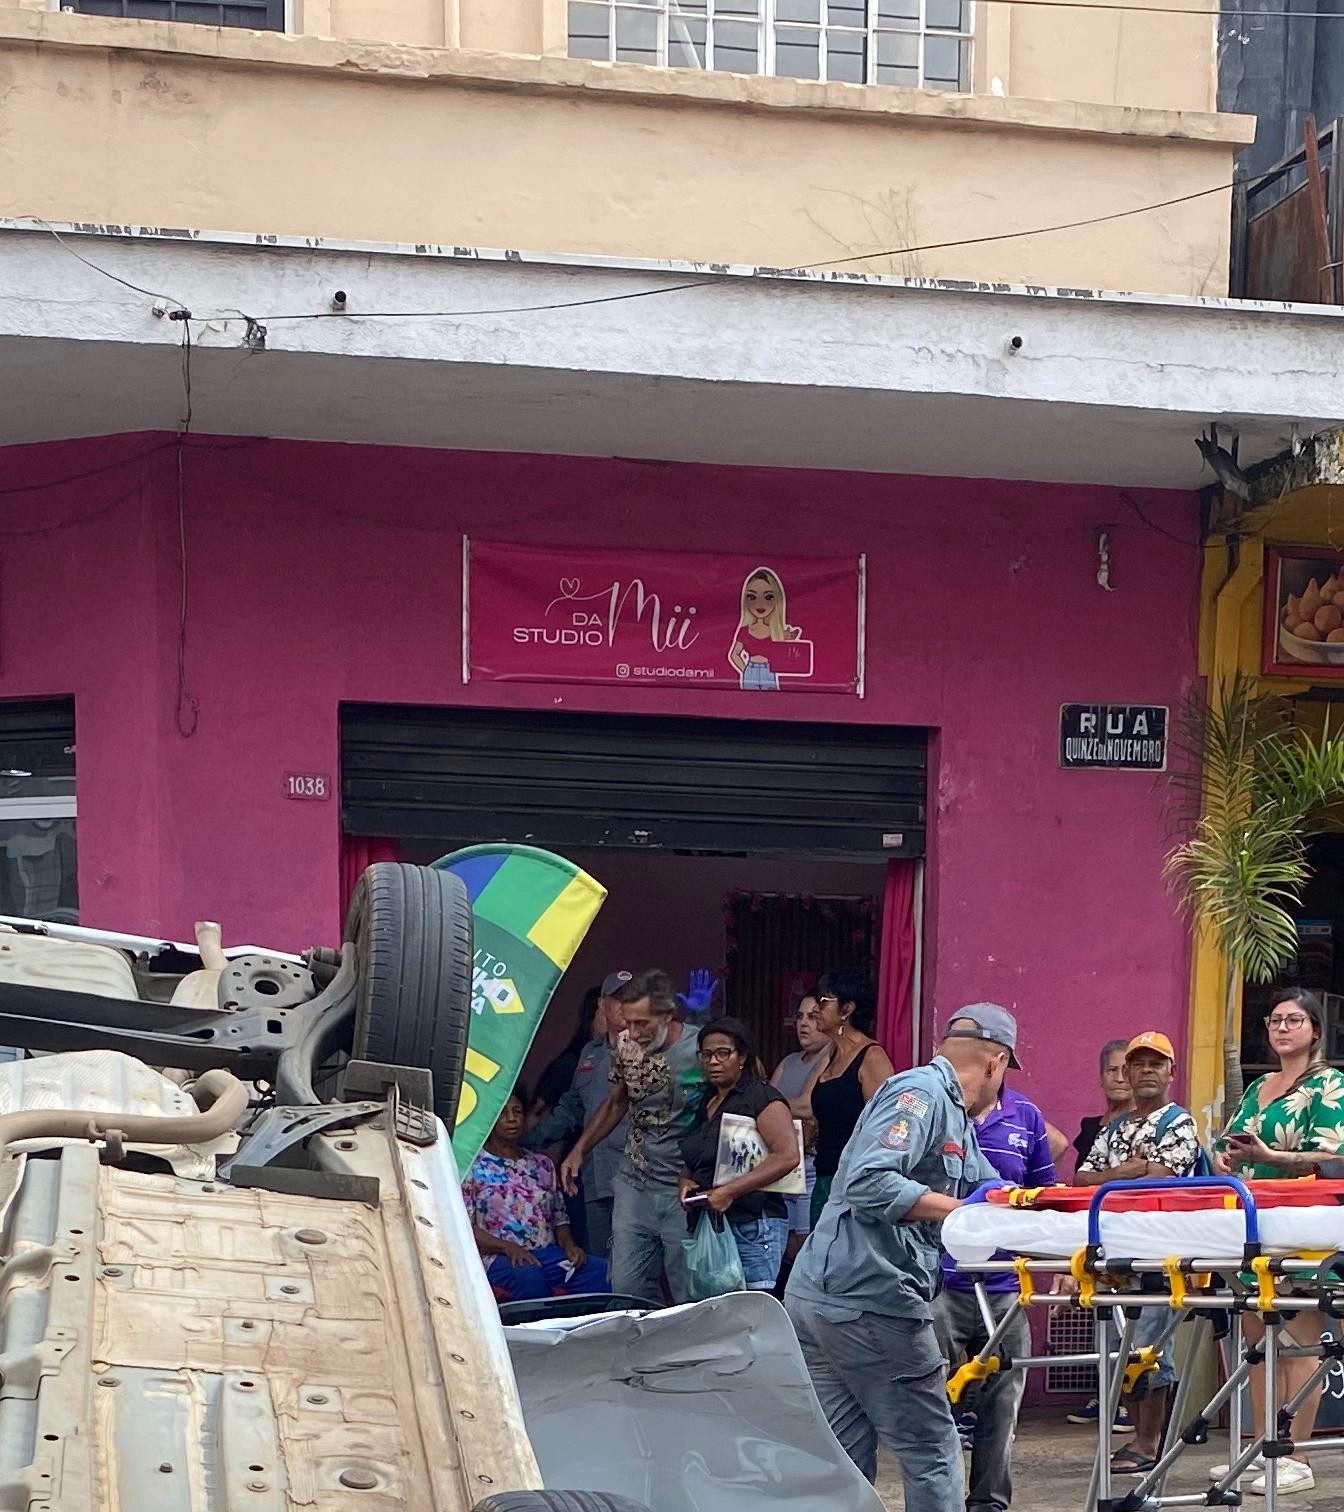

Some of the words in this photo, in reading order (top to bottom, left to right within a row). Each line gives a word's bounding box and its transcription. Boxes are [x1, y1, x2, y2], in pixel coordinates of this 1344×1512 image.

[572, 612, 603, 627] DA
[608, 579, 700, 652] Mii
[513, 627, 603, 646] STUDIO
[1079, 710, 1149, 736] RUA
[1065, 737, 1099, 762] QUINZE
[1107, 738, 1162, 763] NOVEMBRO
[288, 776, 325, 796] 1038
